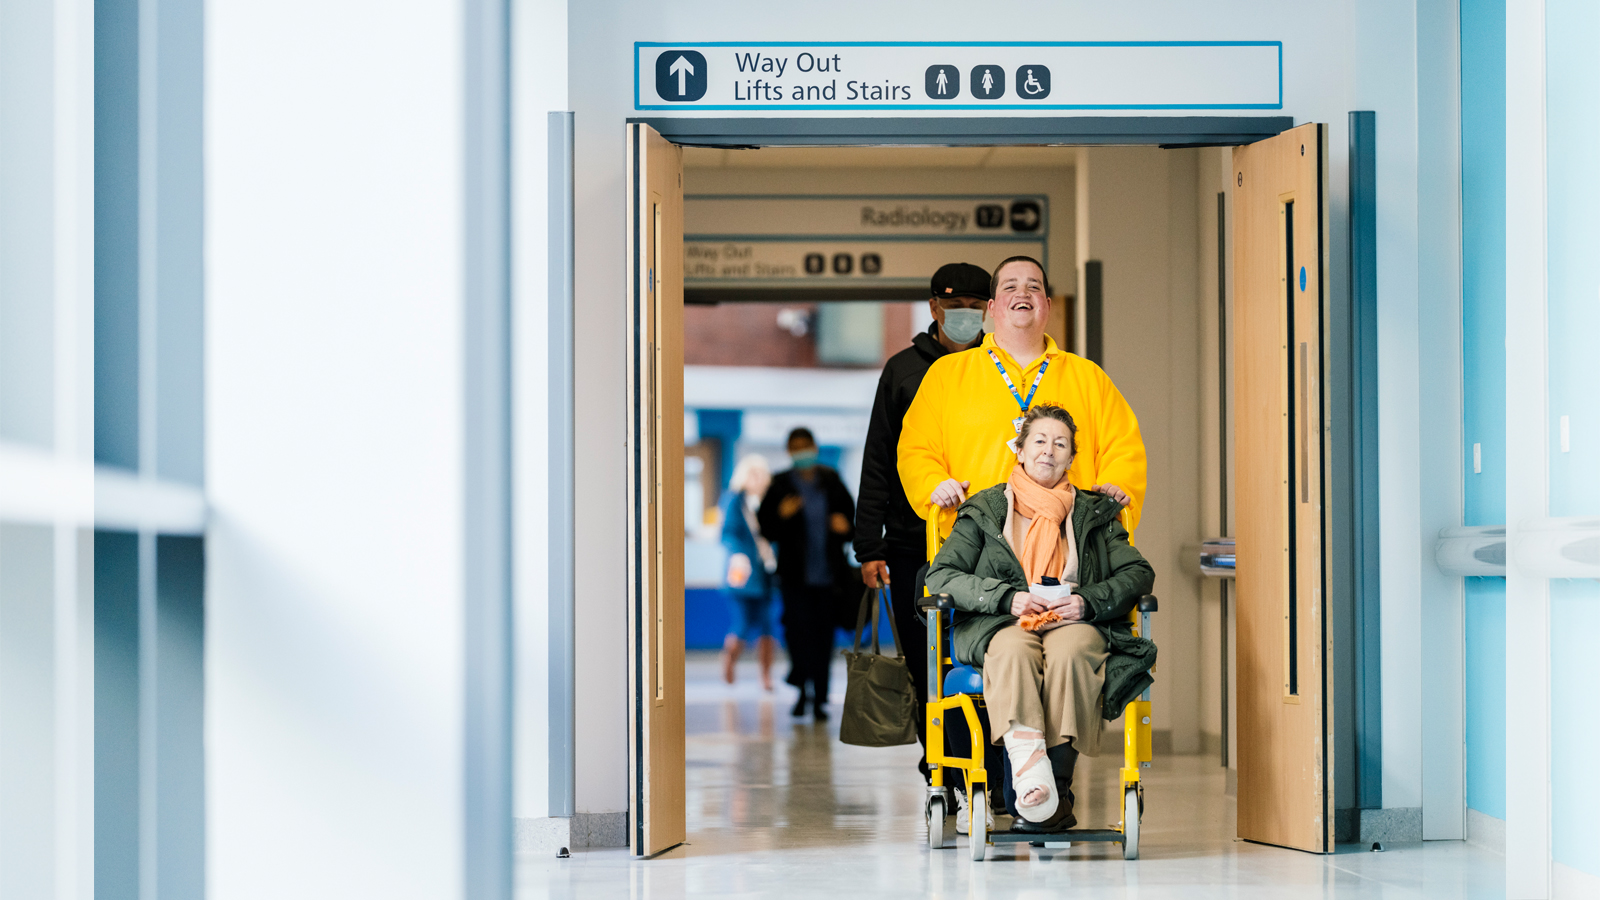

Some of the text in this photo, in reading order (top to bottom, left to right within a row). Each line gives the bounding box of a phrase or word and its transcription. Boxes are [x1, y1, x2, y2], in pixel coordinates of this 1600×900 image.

[735, 52, 841, 78] Way Out
[734, 79, 911, 101] Lifts and Stairs
[860, 205, 970, 232] Radiology
[723, 244, 752, 260] Out
